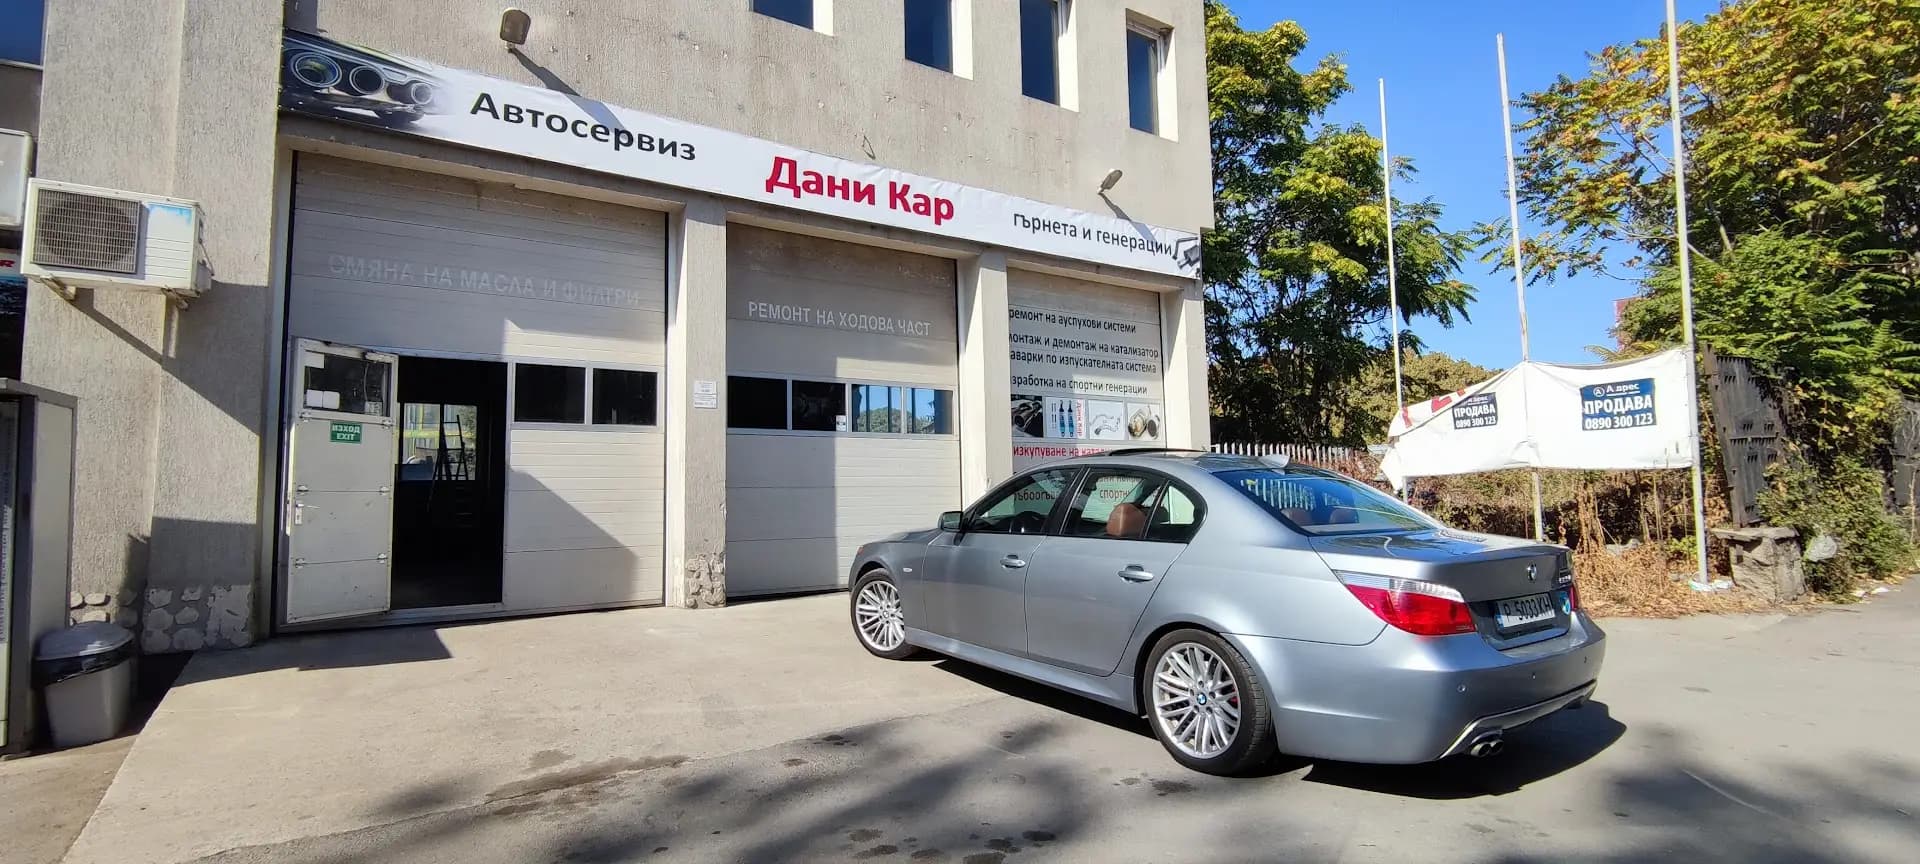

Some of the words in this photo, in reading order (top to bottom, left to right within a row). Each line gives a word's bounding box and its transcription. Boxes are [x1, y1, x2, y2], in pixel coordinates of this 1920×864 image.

[469, 91, 696, 161] Автосервиз
[765, 156, 876, 206] Дани
[888, 181, 955, 226] Кар
[1013, 213, 1077, 237] гърнета
[1082, 227, 1091, 241] и
[1096, 230, 1172, 256] генерации
[328, 254, 415, 281] СМЯНА
[424, 265, 453, 288] НА
[460, 269, 536, 297] МАСЛА
[543, 279, 557, 298] И
[748, 300, 811, 323] РЕМОНТ
[816, 308, 835, 326] НА
[839, 312, 894, 333] ХОДОВА
[897, 319, 931, 337] ЧАСТ
[1009, 308, 1044, 322] ремонт
[1045, 313, 1056, 324] на
[1058, 314, 1102, 330] ауспухови
[1103, 320, 1136, 334] системи
[1044, 337, 1050, 347] и
[1052, 339, 1097, 352] демонтаж
[1099, 343, 1109, 353] на
[1110, 344, 1159, 360] катализатор
[1010, 349, 1044, 364] аварки
[1046, 353, 1057, 365] по
[1059, 354, 1124, 371] изпускателната
[1125, 361, 1156, 374] система
[1012, 374, 1054, 388] зработка
[1056, 380, 1067, 390] на
[1069, 379, 1104, 394] спортни
[1105, 383, 1148, 396] генерации
[1453, 403, 1496, 418] ПРОДАВА
[1584, 394, 1653, 415] ПРОДАВА
[332, 425, 360, 433] ИЗХОД
[1455, 418, 1471, 428] 0890
[1471, 417, 1484, 427] 300
[1484, 415, 1496, 425] 123
[1585, 416, 1612, 430] 0890
[1613, 415, 1633, 428] 300
[1634, 412, 1653, 426] 123
[1013, 446, 1067, 459] изкупуване
[1069, 446, 1079, 456] на
